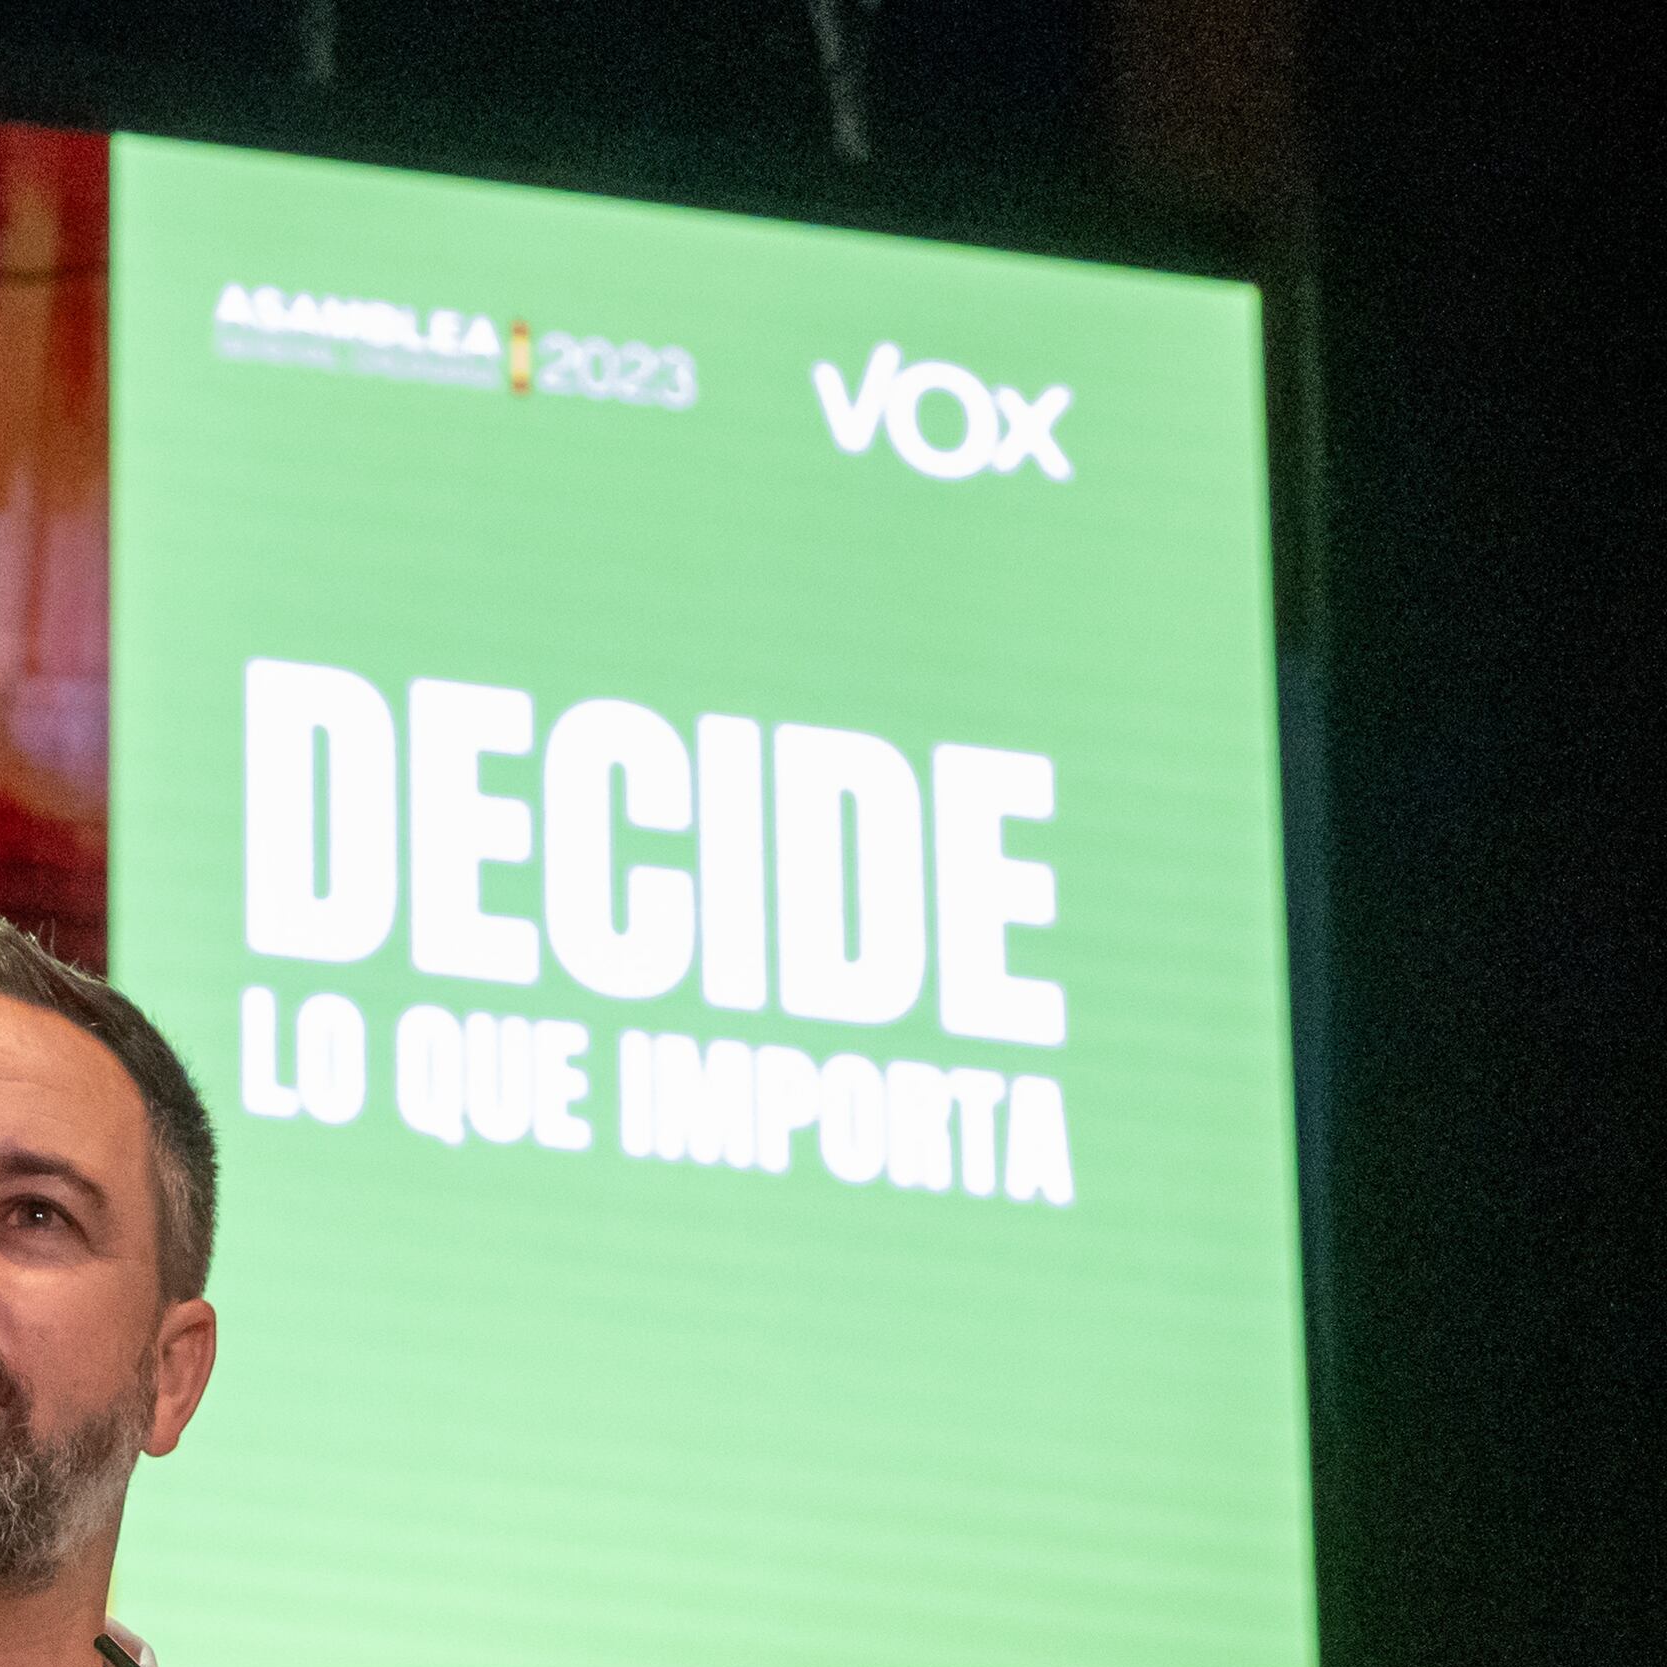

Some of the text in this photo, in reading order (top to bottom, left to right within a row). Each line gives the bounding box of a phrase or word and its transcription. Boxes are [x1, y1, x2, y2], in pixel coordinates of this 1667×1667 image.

[537, 331, 698, 409] 2023
[811, 341, 1074, 482] VOX
[244, 657, 1067, 1047] DECIDE
[240, 985, 1075, 1206] LO QUE IMPORTA
